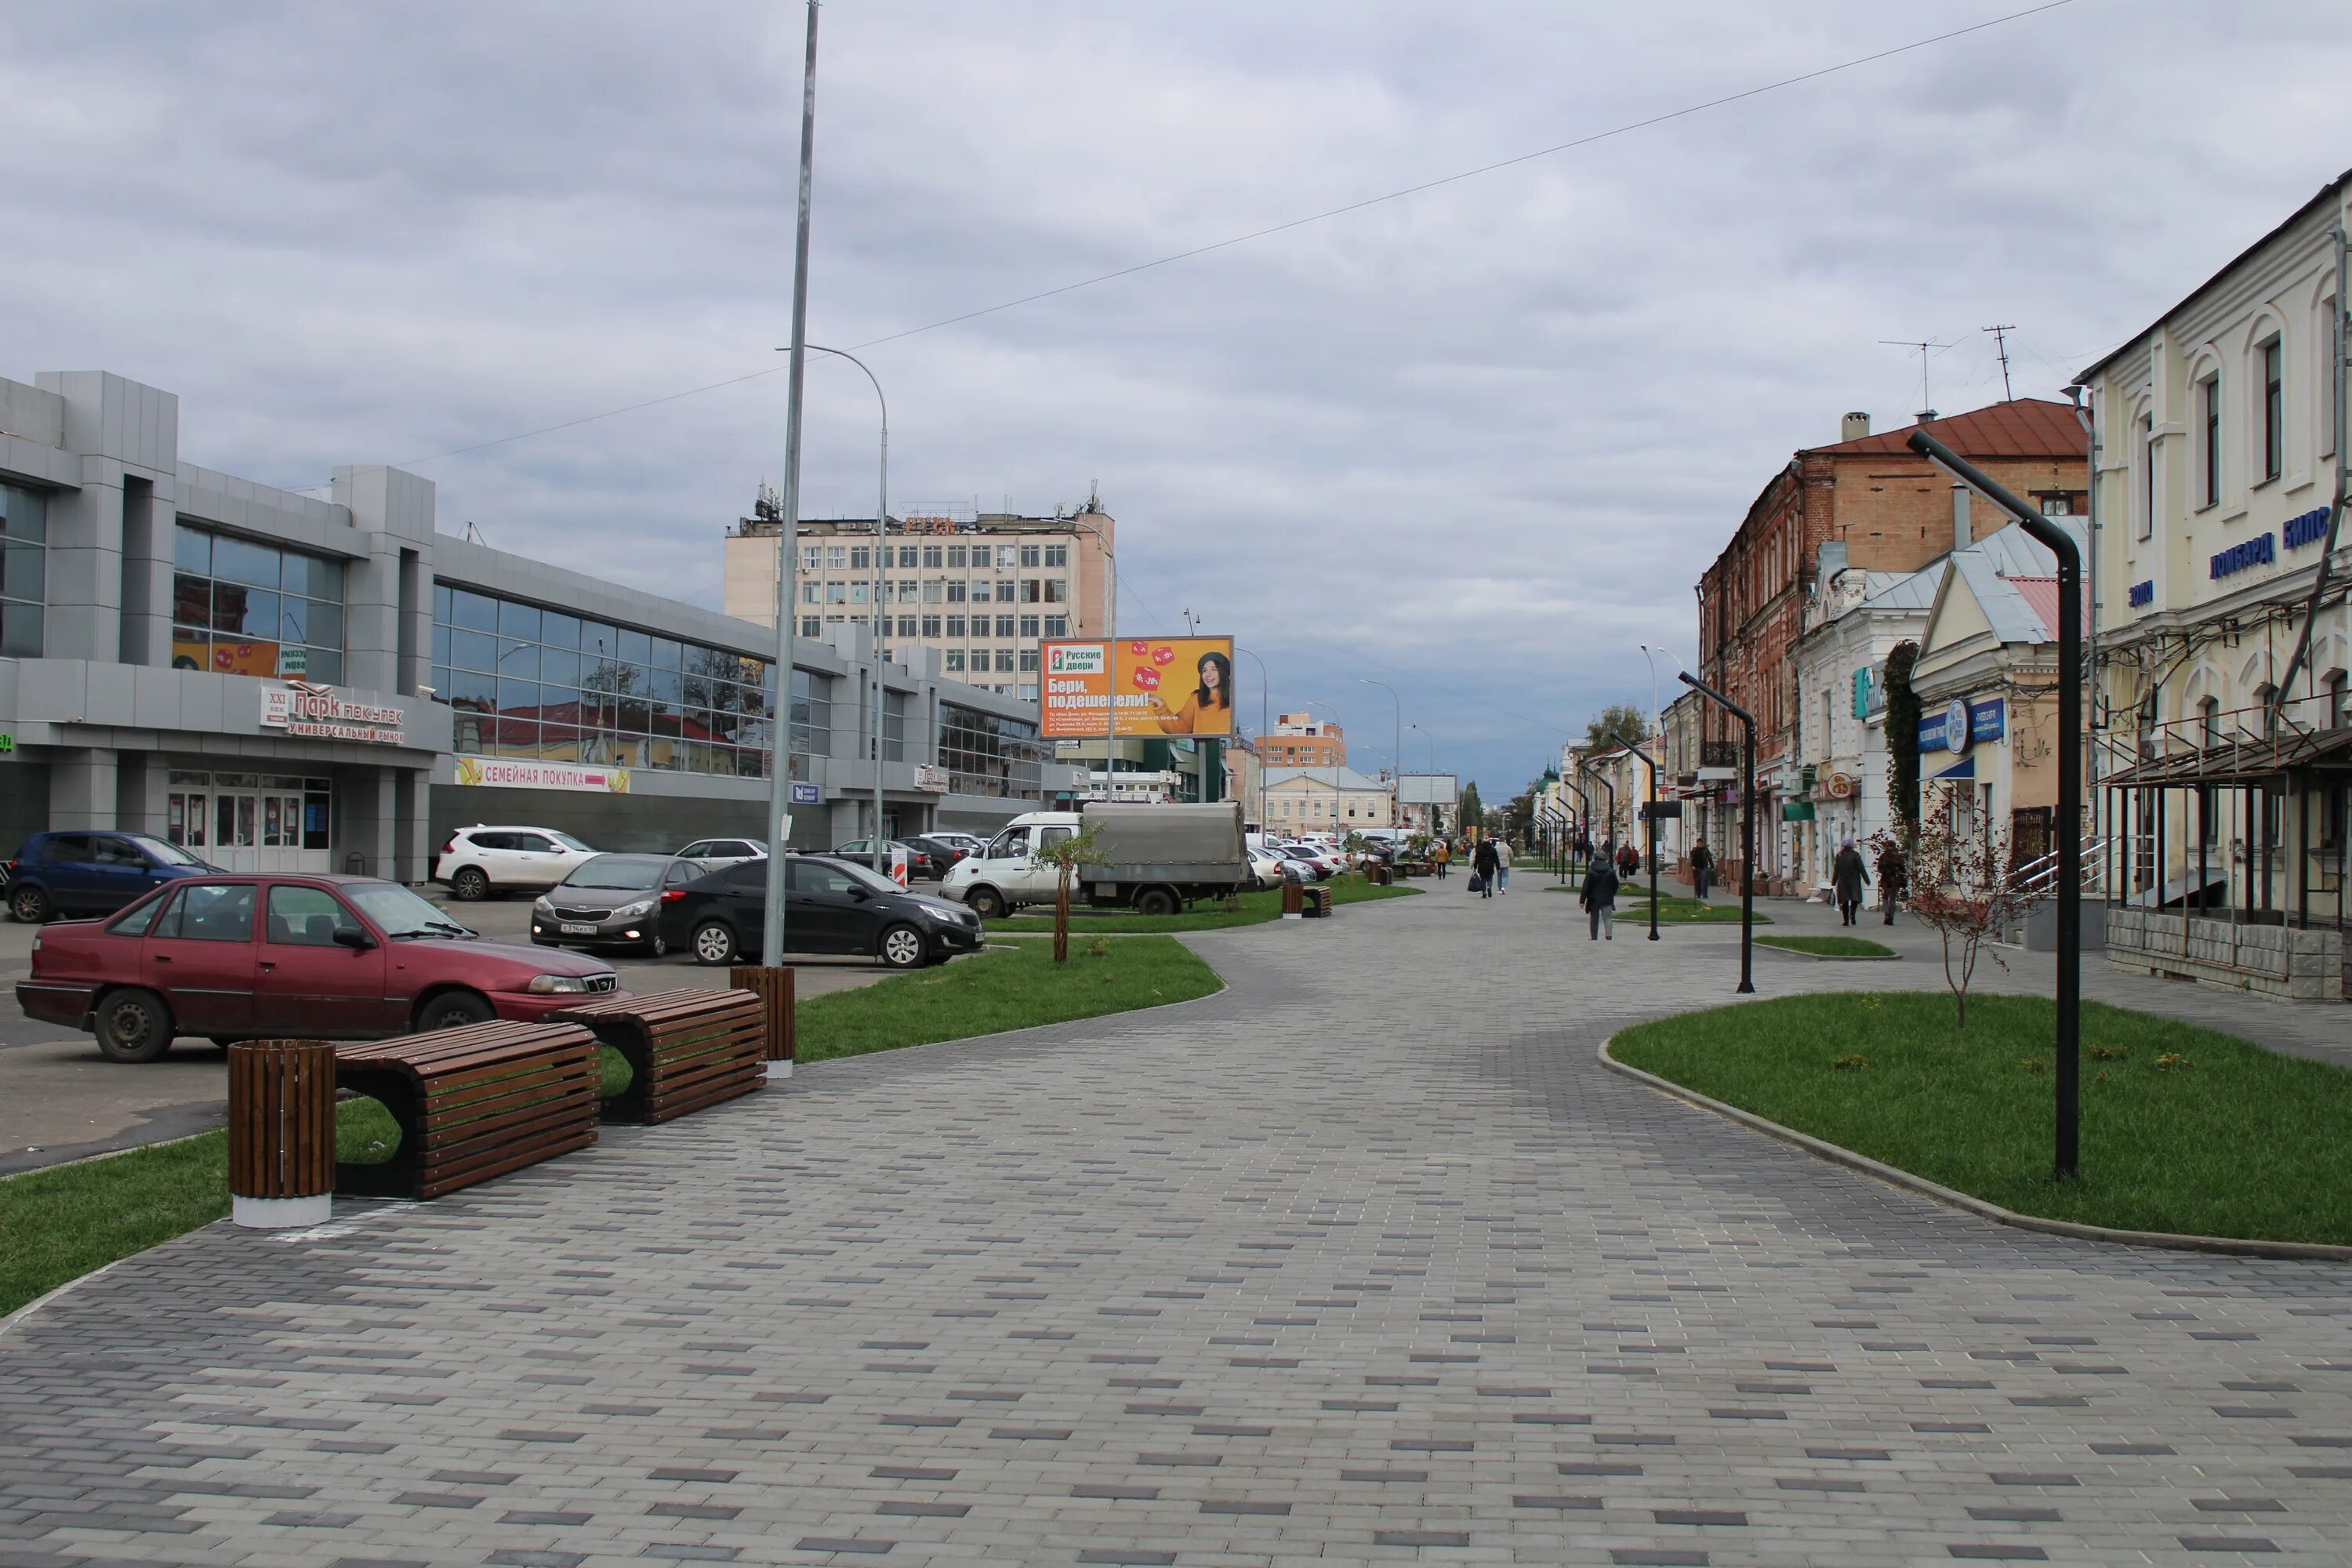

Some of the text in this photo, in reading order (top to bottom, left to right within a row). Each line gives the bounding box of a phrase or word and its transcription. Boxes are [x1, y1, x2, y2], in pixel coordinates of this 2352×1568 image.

[2210, 532, 2274, 579] ЛОМБАРД
[1066, 651, 1101, 660] Русские
[1066, 662, 1093, 671] двери
[1047, 678, 1087, 694] Бери,
[270, 694, 285, 704] XXI
[295, 691, 340, 720] Парк
[289, 723, 404, 742] УНИВЕРСАЛЬНЫЙ РЫНОК
[485, 765, 584, 786] СЕМЕЙНАЯ ПОКУПКА
